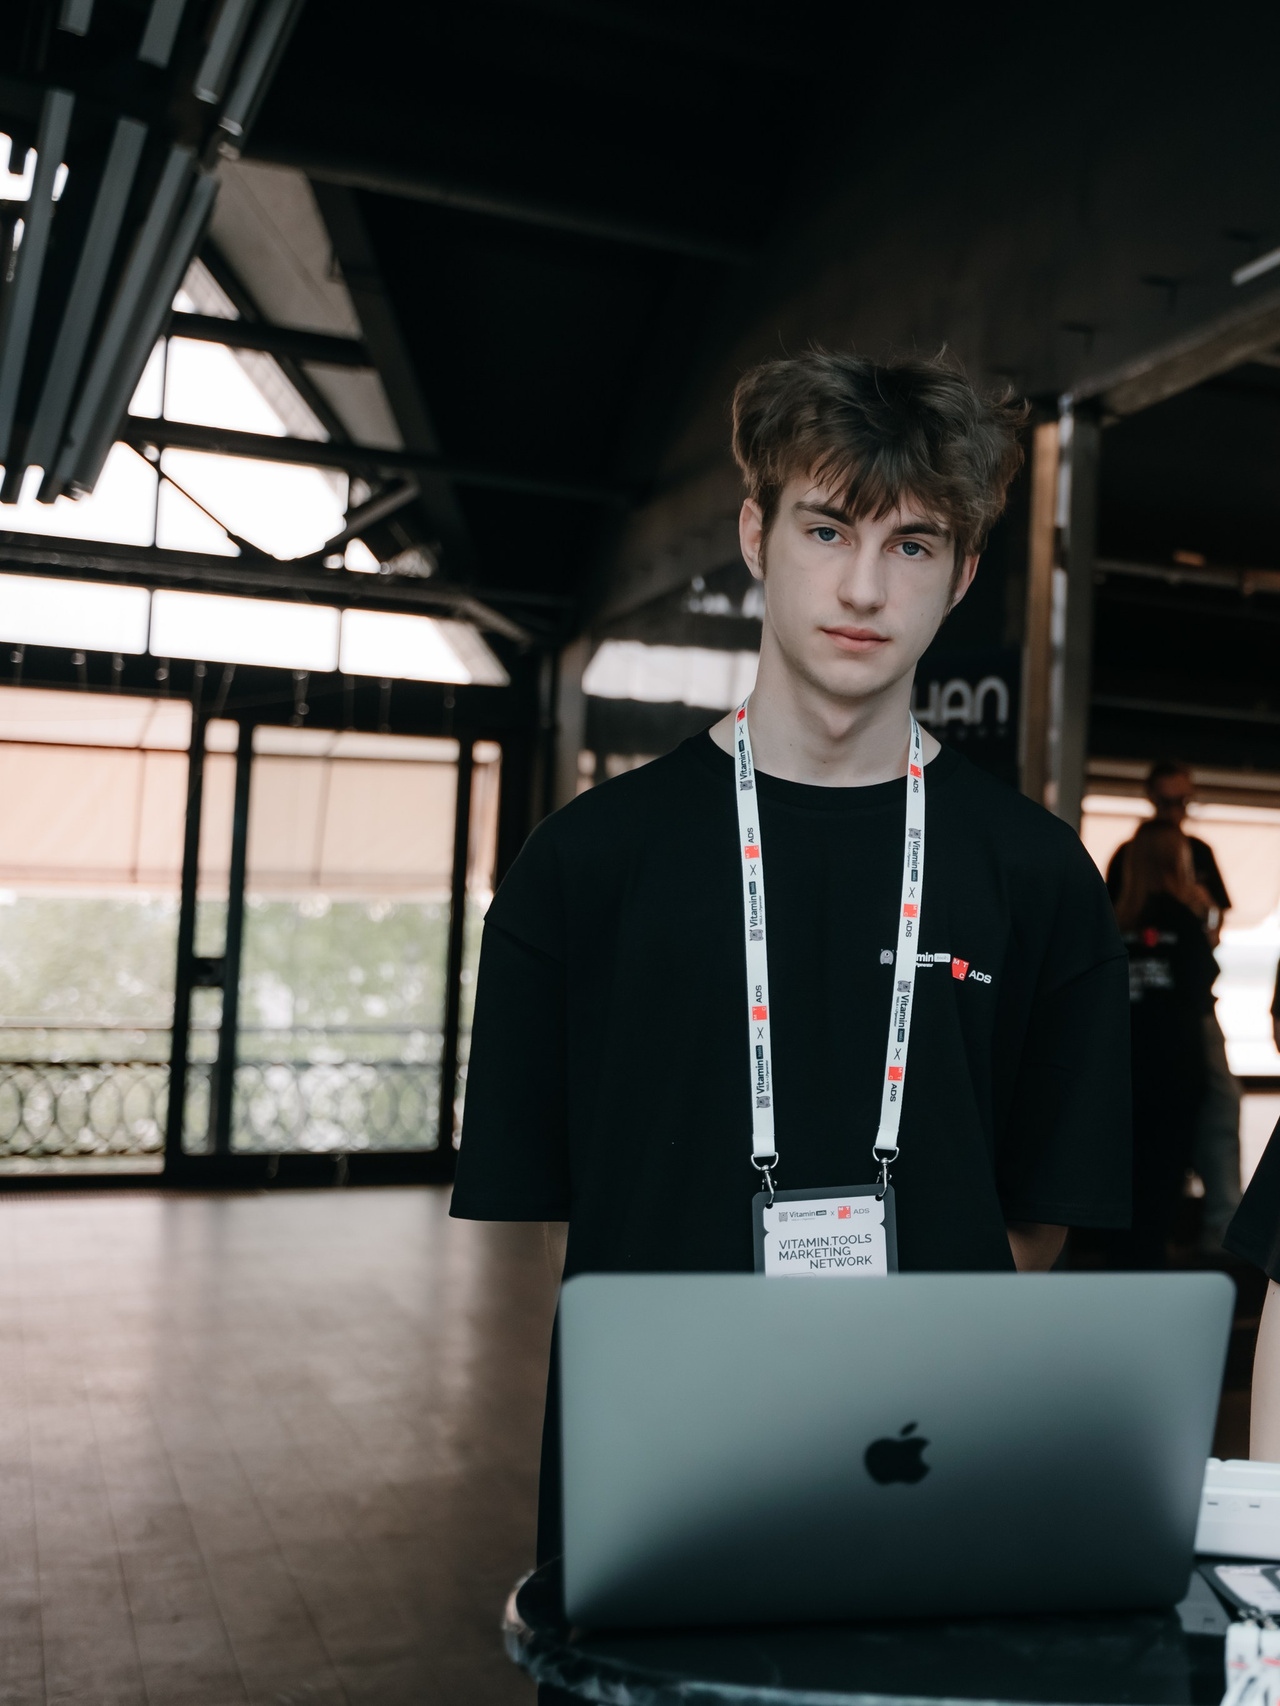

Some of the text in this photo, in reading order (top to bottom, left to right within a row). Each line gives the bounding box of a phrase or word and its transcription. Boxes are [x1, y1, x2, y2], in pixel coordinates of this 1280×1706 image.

[911, 840, 921, 869] Vitamin
[749, 896, 758, 928] Vitamin
[968, 970, 992, 984] ADS
[899, 995, 909, 1027] Vitamin
[755, 1059, 765, 1094] Vitamin
[790, 1210, 816, 1218] Vitamin
[778, 1234, 872, 1250] VITAMIN.TOOLS
[778, 1246, 851, 1261] MARKETING
[810, 1255, 872, 1269] NETWORK
